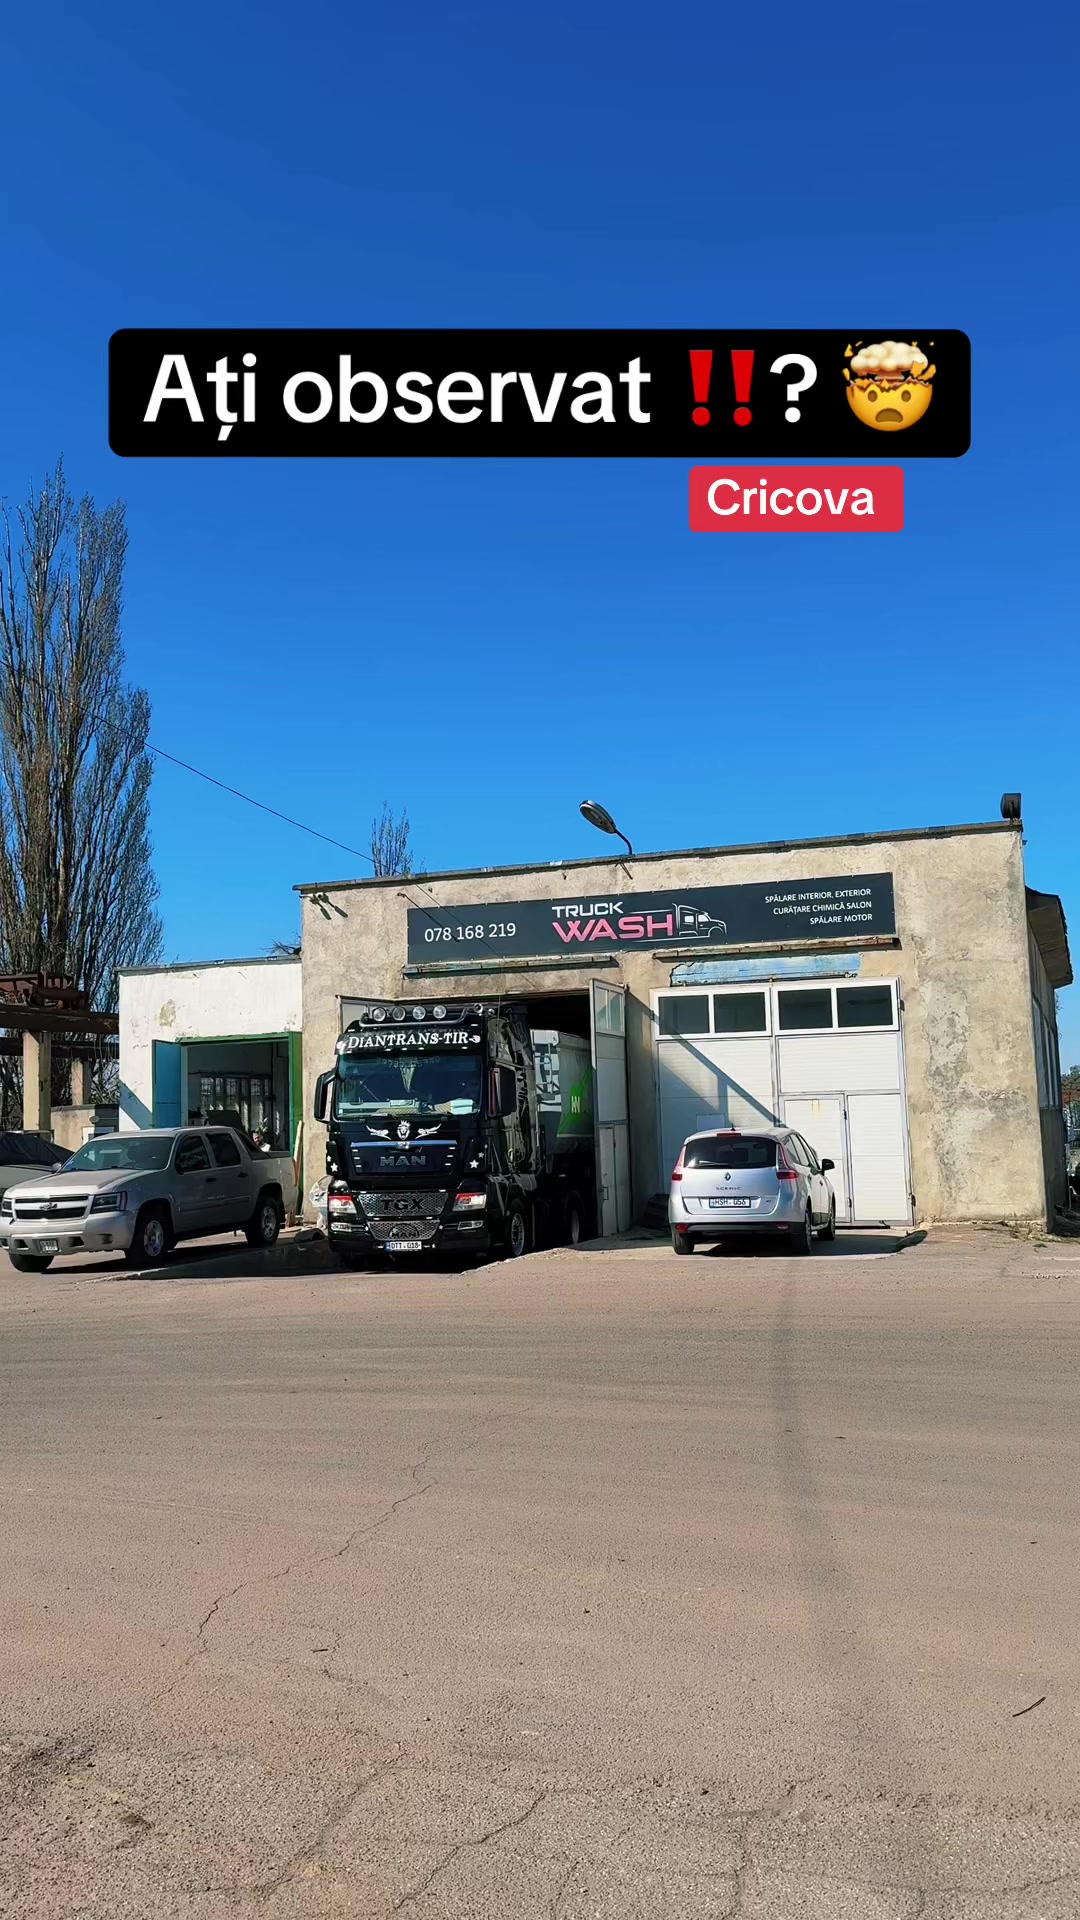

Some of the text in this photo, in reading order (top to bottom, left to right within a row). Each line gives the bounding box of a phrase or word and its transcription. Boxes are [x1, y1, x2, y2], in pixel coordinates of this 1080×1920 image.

[835, 888, 871, 898] EXTERIOR
[552, 901, 624, 918] TRUCK
[846, 901, 872, 909] SALON
[844, 914, 873, 922] MOTOR
[424, 922, 516, 942] 078 168 219
[552, 914, 673, 943] WASH
[380, 1155, 426, 1166] MAN
[381, 1199, 424, 1210] TGX
